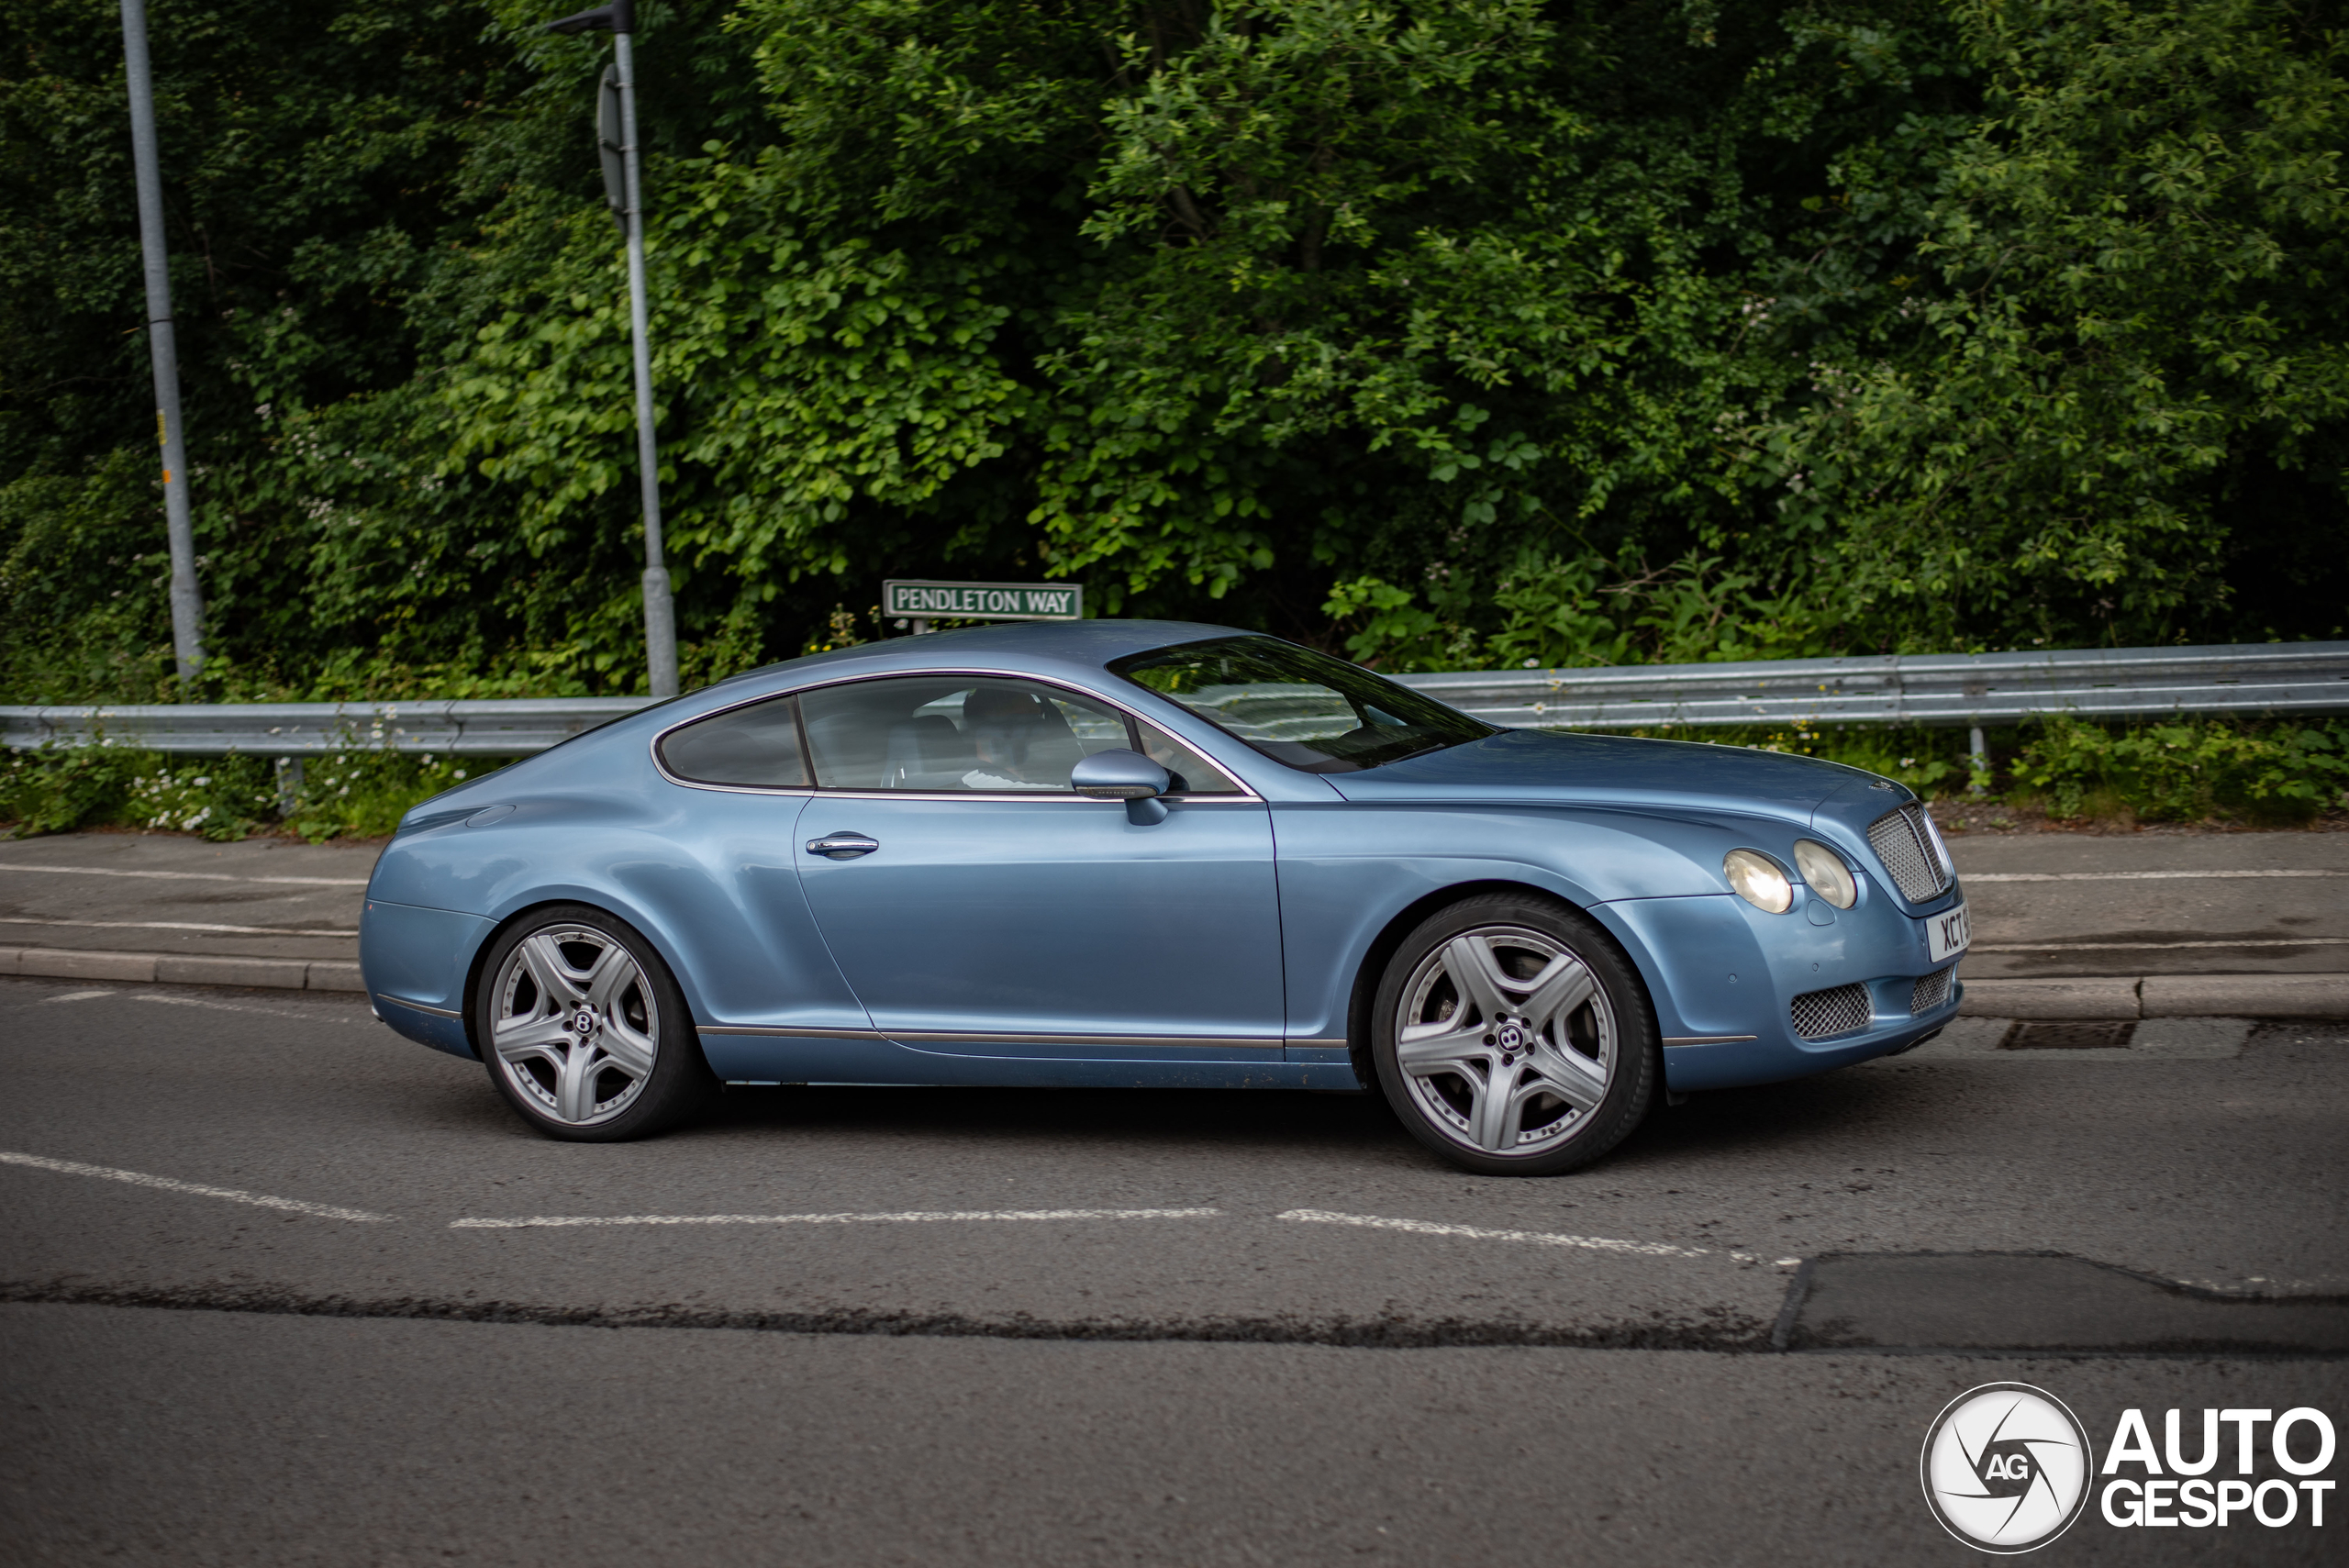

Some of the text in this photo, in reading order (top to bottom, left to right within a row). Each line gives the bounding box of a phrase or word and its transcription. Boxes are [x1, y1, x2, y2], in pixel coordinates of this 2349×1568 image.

[896, 588, 1073, 613] PENDLETON WAY
[1941, 912, 1963, 951] XCT
[575, 1015, 590, 1032] B
[1500, 1028, 1520, 1050] B
